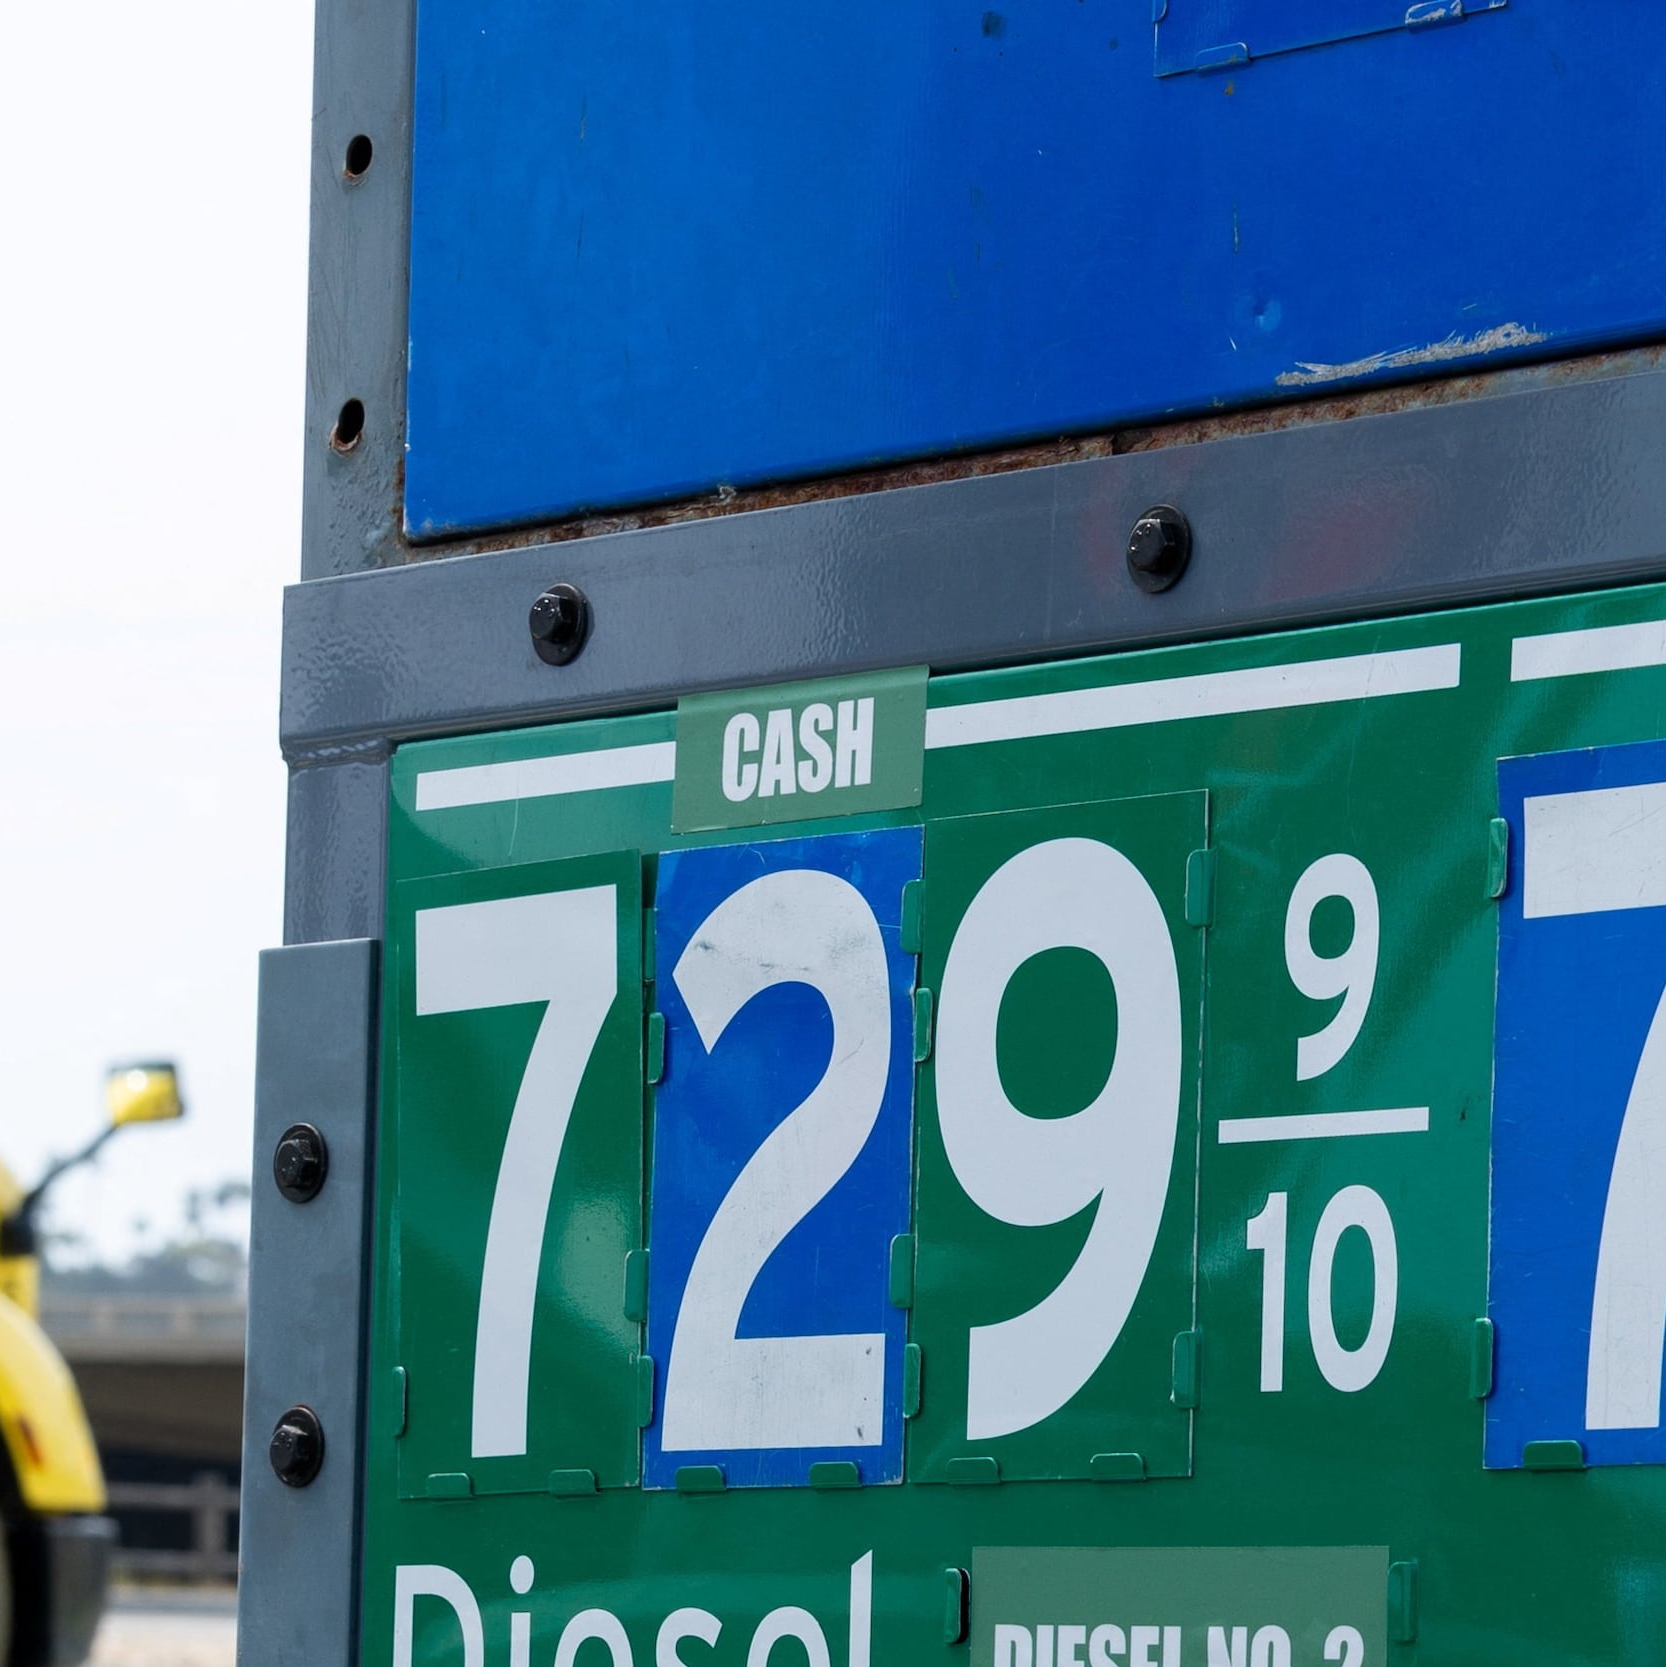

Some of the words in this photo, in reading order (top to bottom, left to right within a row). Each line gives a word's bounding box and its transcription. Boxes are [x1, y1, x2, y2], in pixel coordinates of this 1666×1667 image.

[721, 697, 875, 803] CASH
[1283, 852, 1381, 1082] 9
[414, 836, 1183, 1459] 729
[1245, 1183, 1399, 1393] 10
